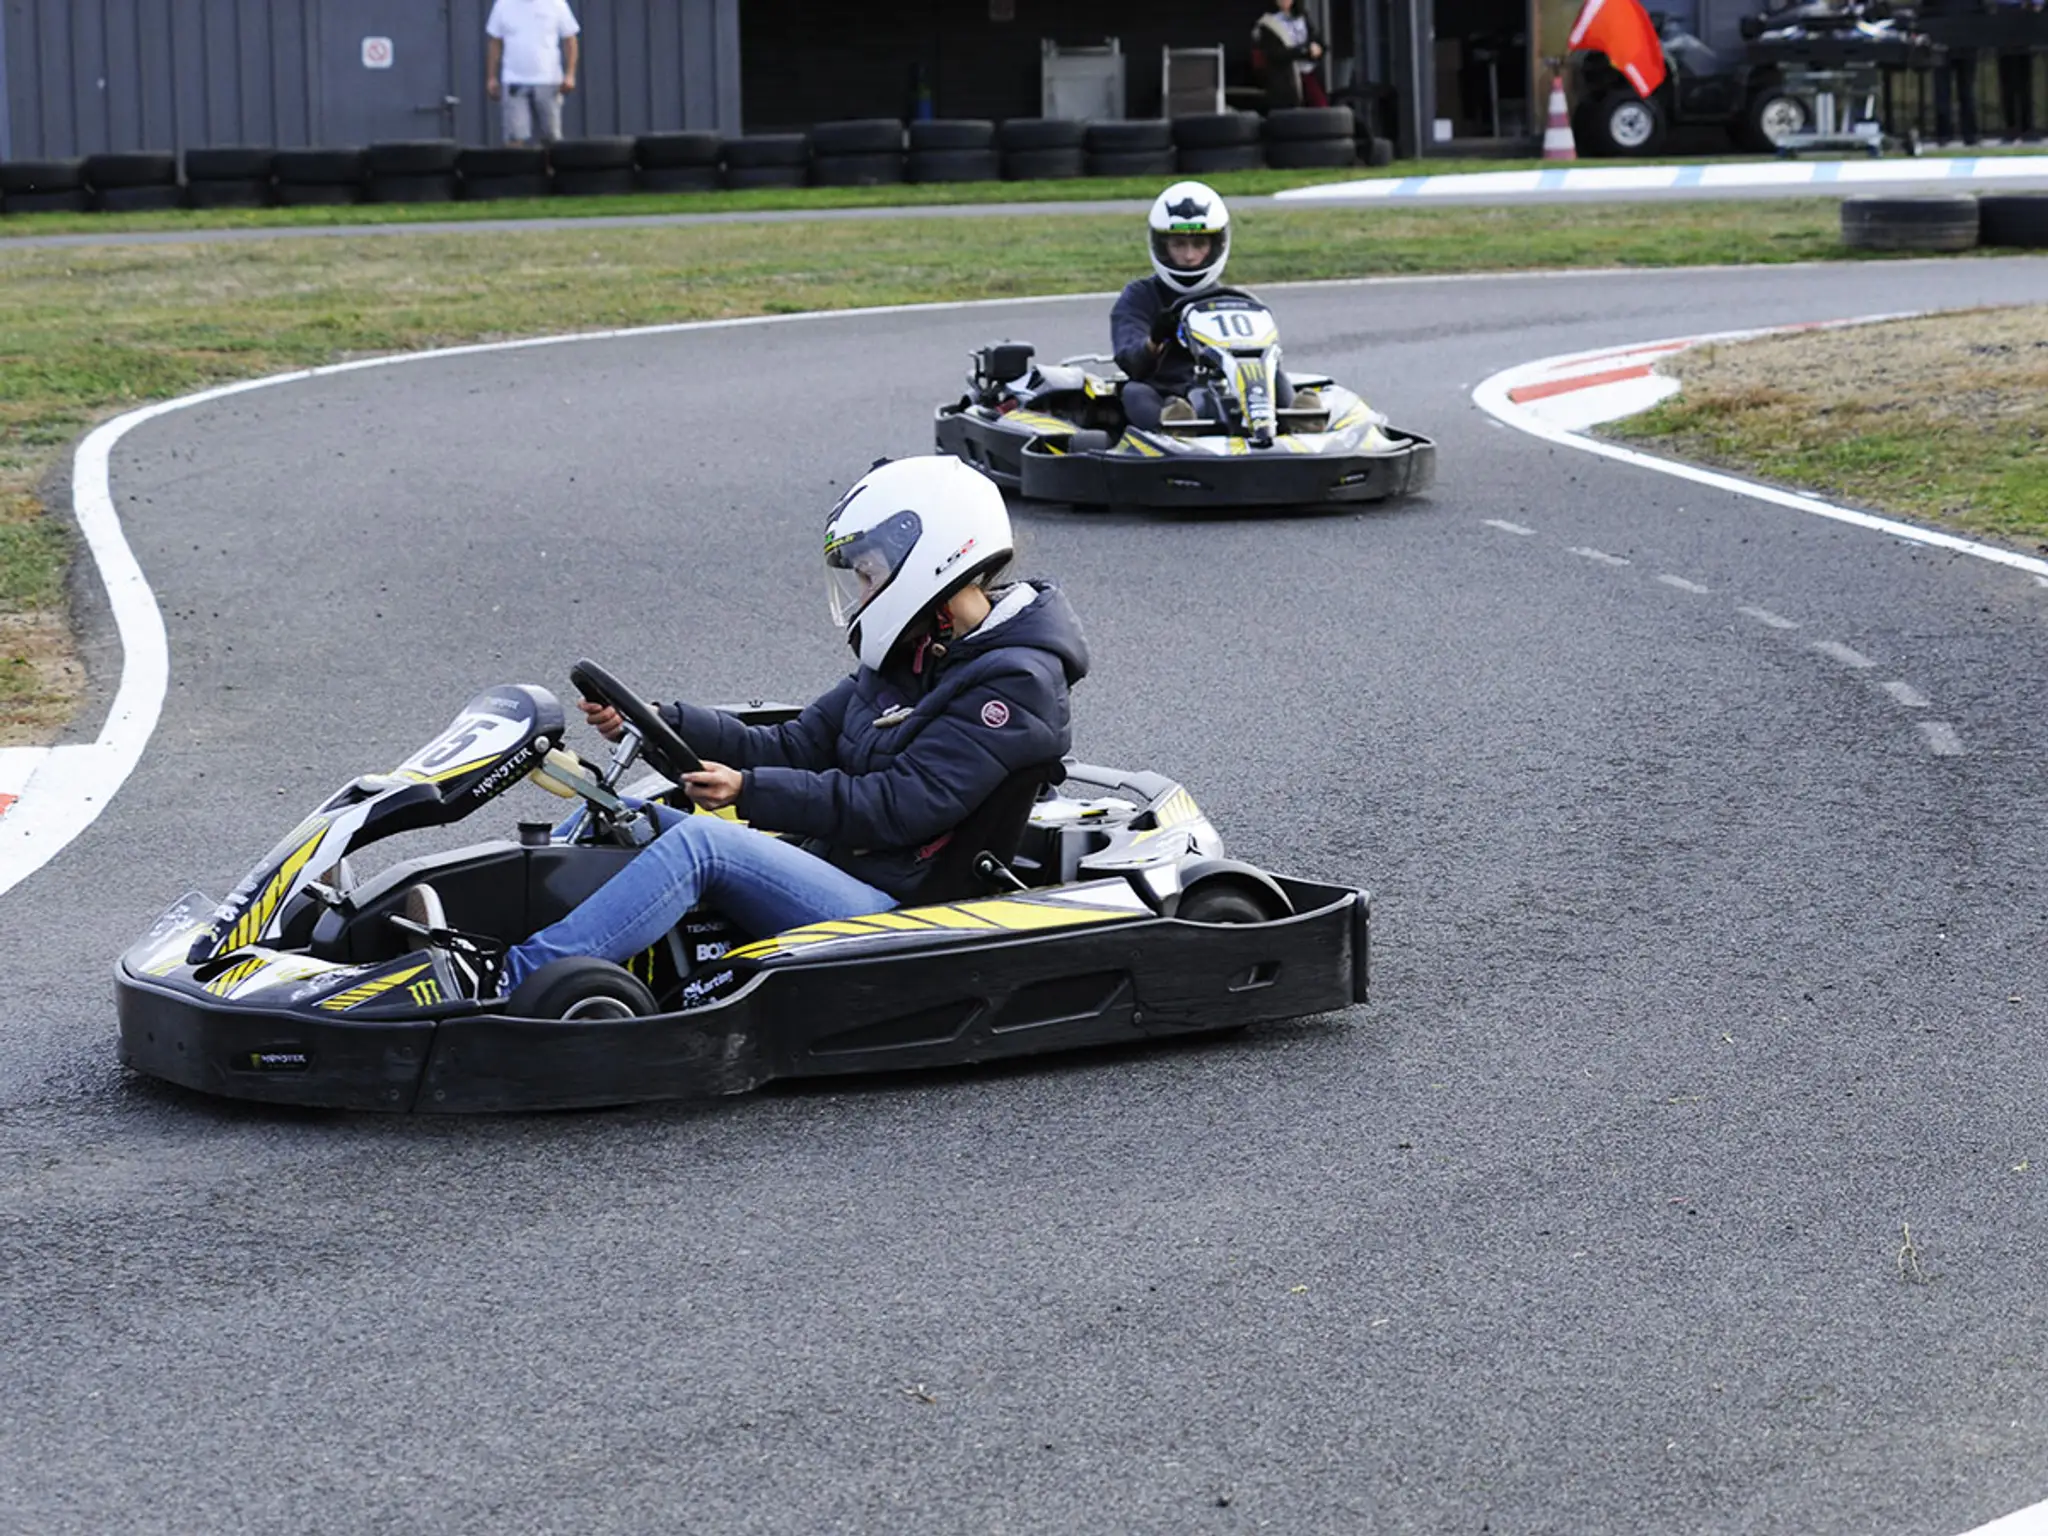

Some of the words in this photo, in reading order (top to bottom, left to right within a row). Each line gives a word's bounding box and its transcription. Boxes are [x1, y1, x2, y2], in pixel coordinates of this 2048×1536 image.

[1211, 313, 1254, 338] 10
[472, 747, 533, 798] MONSTER
[261, 1053, 307, 1064] MONSTER
